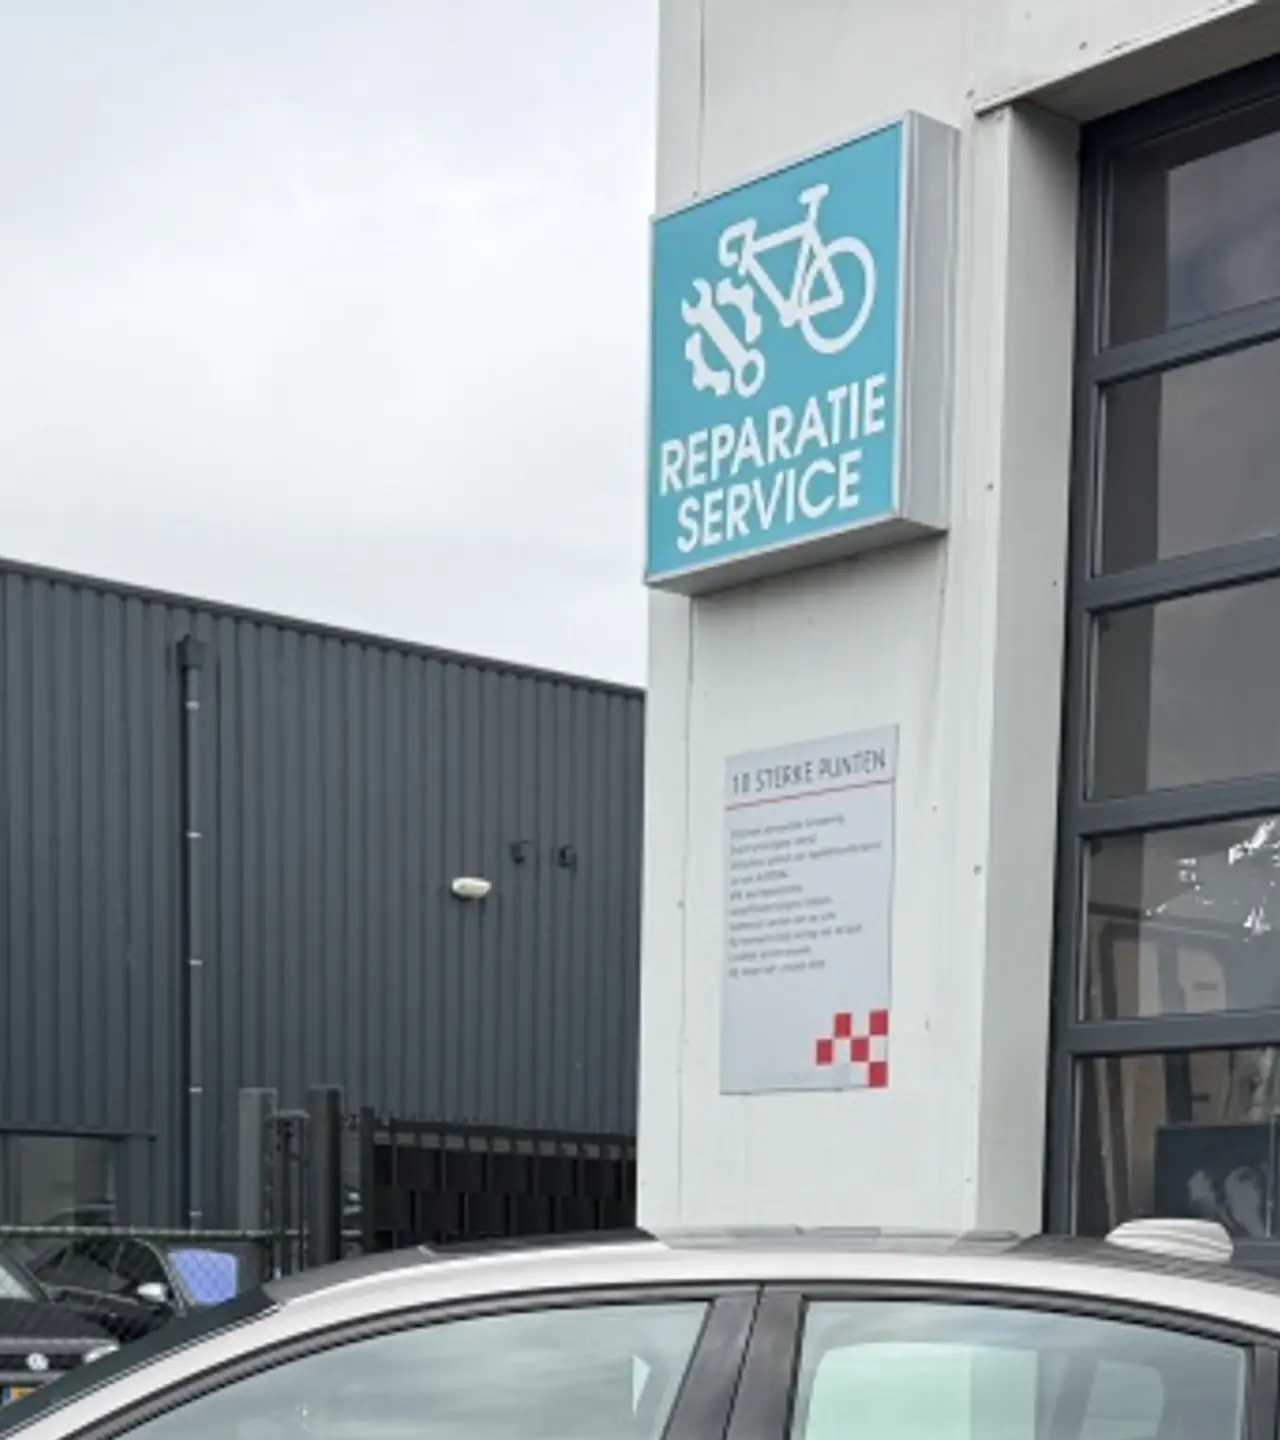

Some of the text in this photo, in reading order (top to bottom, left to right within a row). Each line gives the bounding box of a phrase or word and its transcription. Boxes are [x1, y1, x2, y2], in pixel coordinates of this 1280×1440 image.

[660, 373, 887, 496] REPARATIE
[677, 450, 862, 553] SERVICE
[818, 748, 886, 779] PUNTEN
